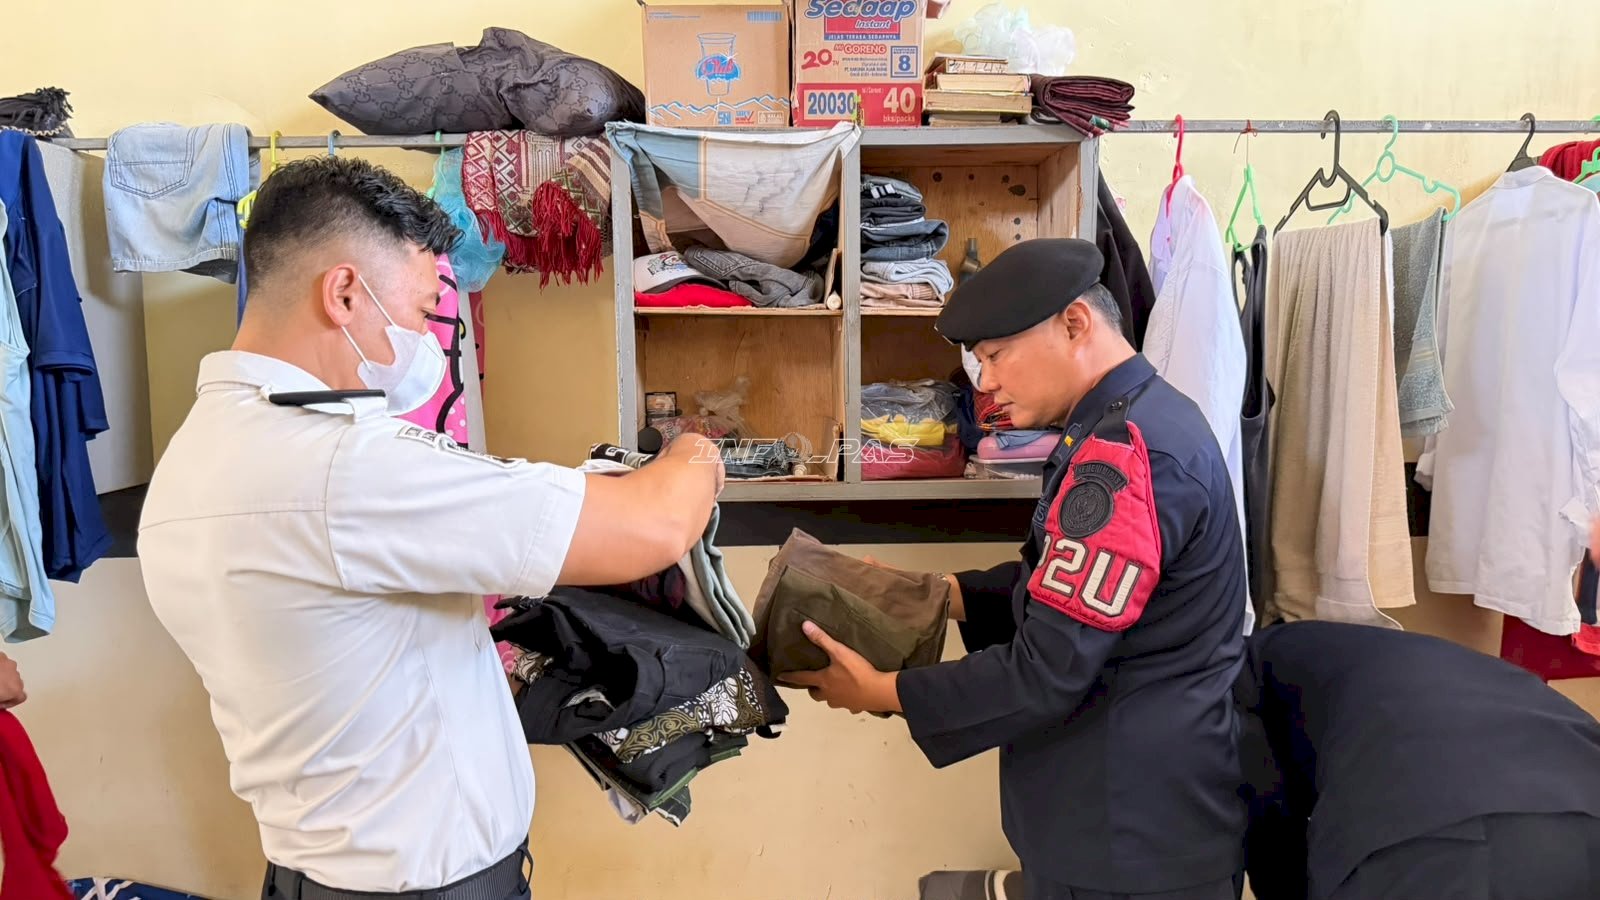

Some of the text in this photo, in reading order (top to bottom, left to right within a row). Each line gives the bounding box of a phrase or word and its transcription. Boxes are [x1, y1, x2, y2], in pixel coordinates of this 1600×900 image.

[804, 0, 917, 21] Sedaap
[855, 20, 891, 29] Instant
[844, 43, 887, 54] GORENG
[801, 49, 832, 69] 20
[899, 55, 911, 71] 8
[807, 92, 856, 115] 20030
[883, 87, 915, 113] 40
